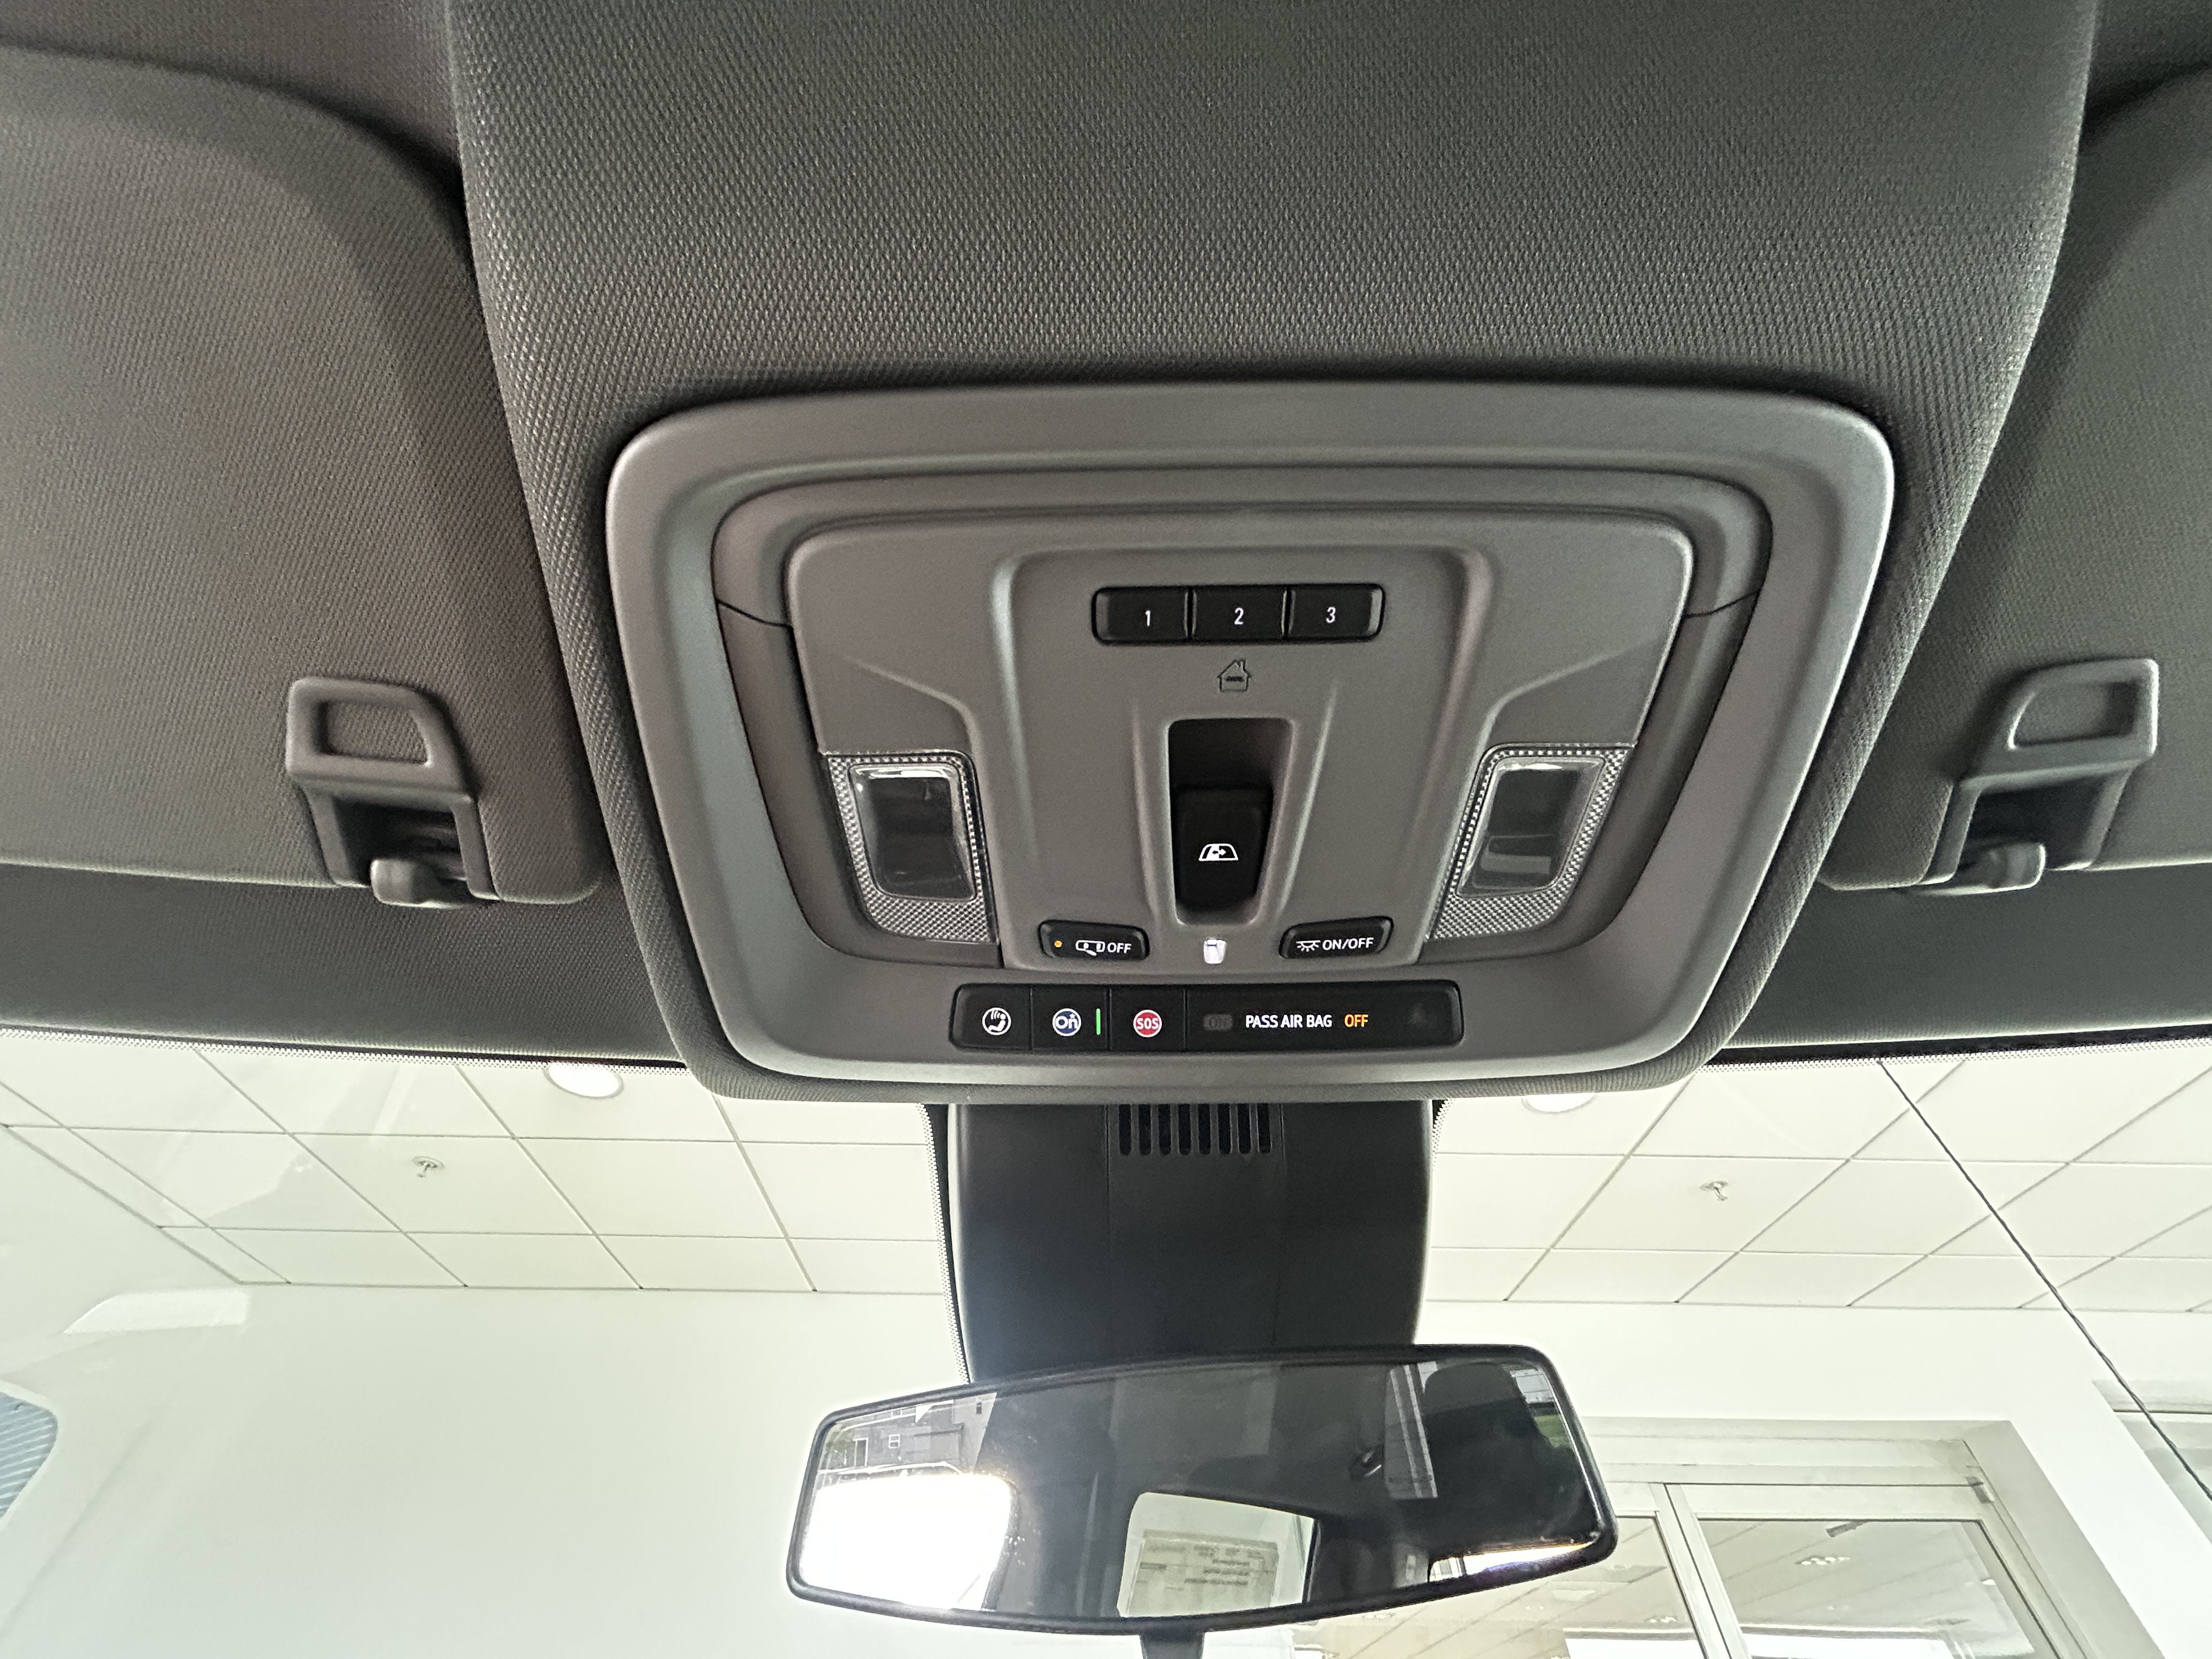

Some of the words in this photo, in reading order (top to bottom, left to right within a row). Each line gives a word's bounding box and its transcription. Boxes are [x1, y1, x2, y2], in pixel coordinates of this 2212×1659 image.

[1145, 610, 1151, 627] 1
[1234, 607, 1244, 625] 2
[1325, 606, 1336, 623] 3
[1107, 942, 1132, 953] OFF
[1322, 937, 1374, 951] ON/OFF
[1136, 1017, 1159, 1030] SOS
[1245, 1014, 1279, 1028] PASS
[1280, 1014, 1304, 1028] AIR
[1306, 1014, 1333, 1028] BAG
[1344, 1014, 1369, 1028] OFF
